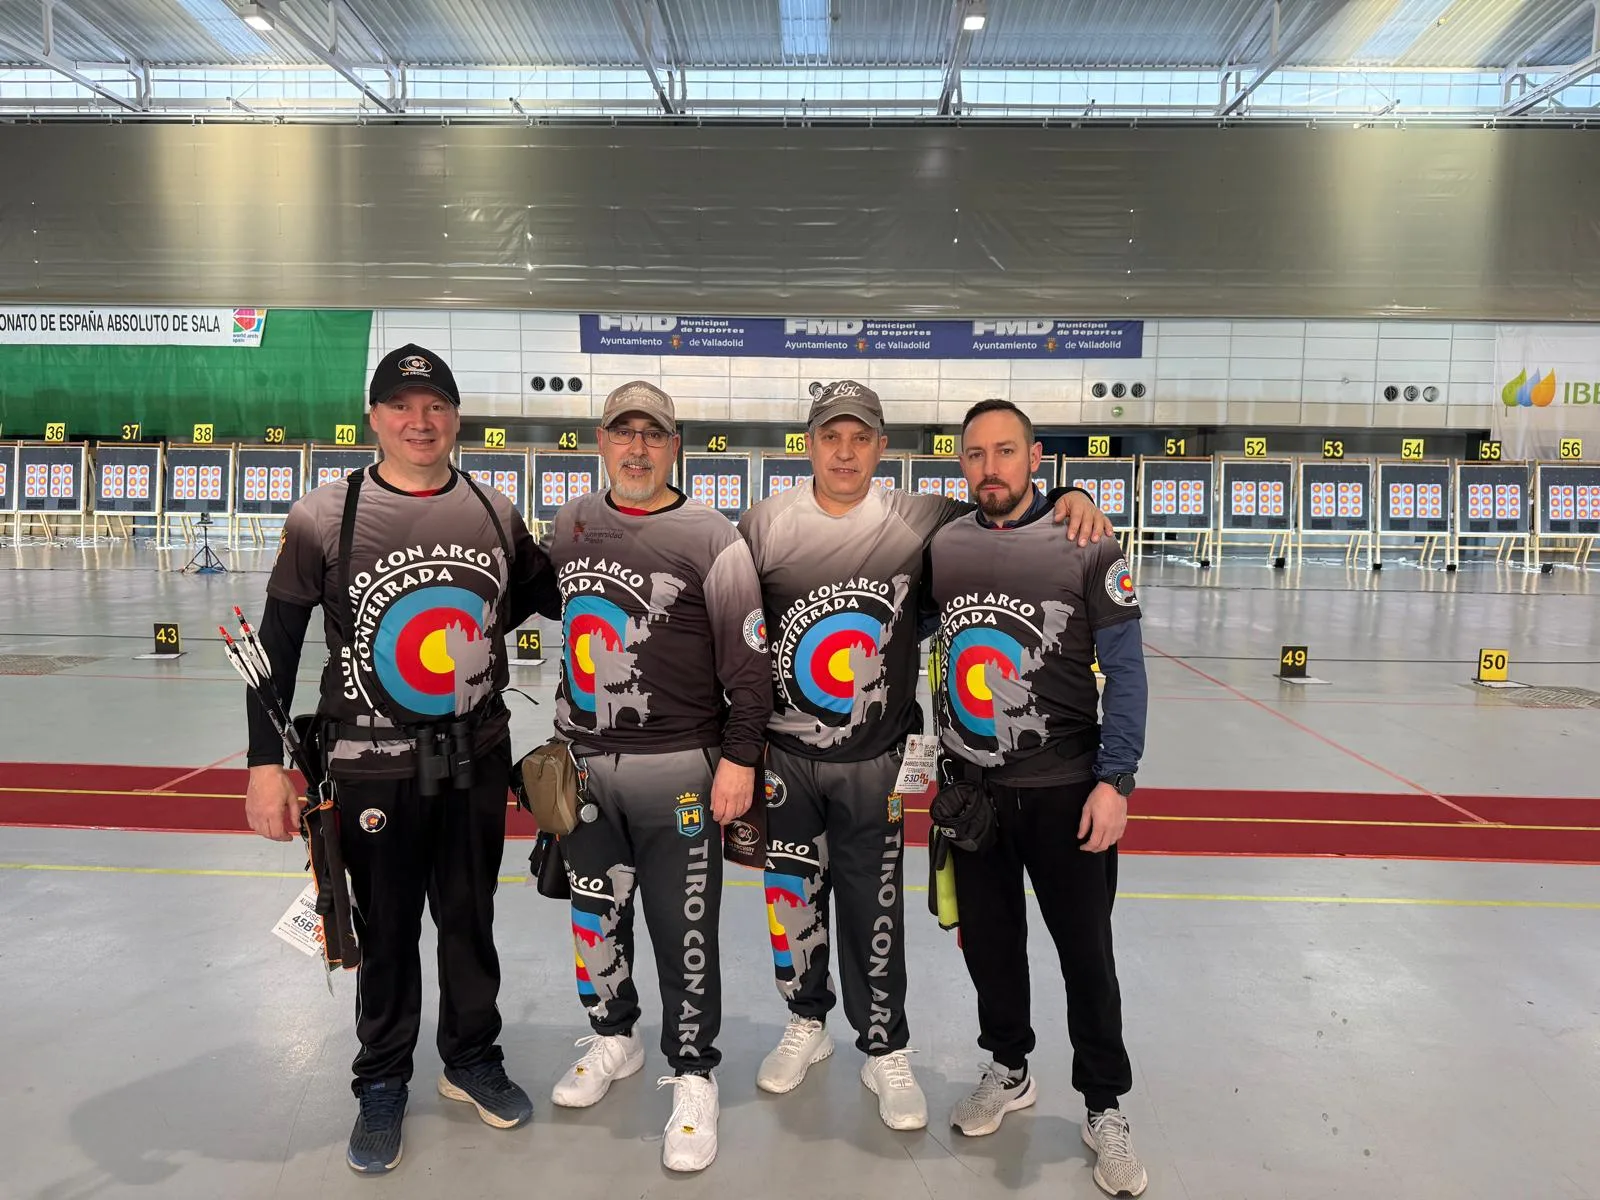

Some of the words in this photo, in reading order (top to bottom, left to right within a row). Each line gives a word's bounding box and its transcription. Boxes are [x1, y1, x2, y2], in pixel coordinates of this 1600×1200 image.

[40, 314, 56, 331] DE
[60, 310, 104, 331] ESPAÑA
[107, 314, 169, 332] ABSOLUTO
[172, 315, 188, 331] DE
[192, 315, 220, 332] SALA
[681, 319, 729, 327] Municipal
[867, 322, 916, 330] Municipal
[1057, 322, 1108, 330] Municipal
[881, 329, 931, 337] Deportes
[1072, 329, 1123, 337] Deportes
[600, 337, 663, 346] Ayuntamiento
[689, 337, 701, 346] de
[702, 338, 744, 347] Valladolid
[785, 340, 848, 350] Ayuntamiento
[874, 341, 886, 349] de
[887, 341, 931, 349] Valladolid
[972, 341, 1038, 351] Ayuntamiento
[1065, 341, 1077, 349] de
[1078, 341, 1122, 349] Valladolid
[46, 426, 64, 440] 36
[122, 425, 140, 440] 37
[194, 428, 212, 442] 38
[265, 428, 284, 443] 39
[337, 428, 355, 442] 40
[486, 433, 505, 447] 42
[559, 433, 577, 448] 43
[708, 436, 727, 451] 45
[787, 437, 804, 452] 46
[934, 438, 953, 453] 48
[1090, 440, 1109, 454] 50
[1166, 439, 1186, 454] 51
[1246, 441, 1265, 456] 52
[1324, 441, 1344, 457] 53
[1403, 443, 1422, 457] 54
[1481, 443, 1500, 459] 55
[1561, 442, 1580, 457] 56
[375, 545, 424, 574] CON
[431, 544, 491, 568] ARCO
[559, 557, 590, 578] CON
[594, 558, 644, 587] ARCO
[779, 599, 806, 630] TIRO
[845, 577, 889, 595] ARCO
[947, 592, 978, 613] CON
[983, 592, 1035, 617] ARCO
[357, 567, 454, 672] PONFERRADA
[156, 628, 177, 644] 43
[518, 633, 540, 650] 45
[782, 597, 860, 679] PONFERRADA
[1282, 650, 1306, 667] 49
[1482, 654, 1506, 670] 50
[341, 646, 359, 700] CLUB
[903, 774, 920, 783] 53D
[877, 828, 901, 908] TIRO
[567, 870, 604, 891] RCO
[684, 839, 709, 921] TIRO
[292, 915, 315, 932] 45B
[301, 909, 321, 924] JOSE
[867, 915, 894, 977] CON
[683, 929, 706, 995] CON
